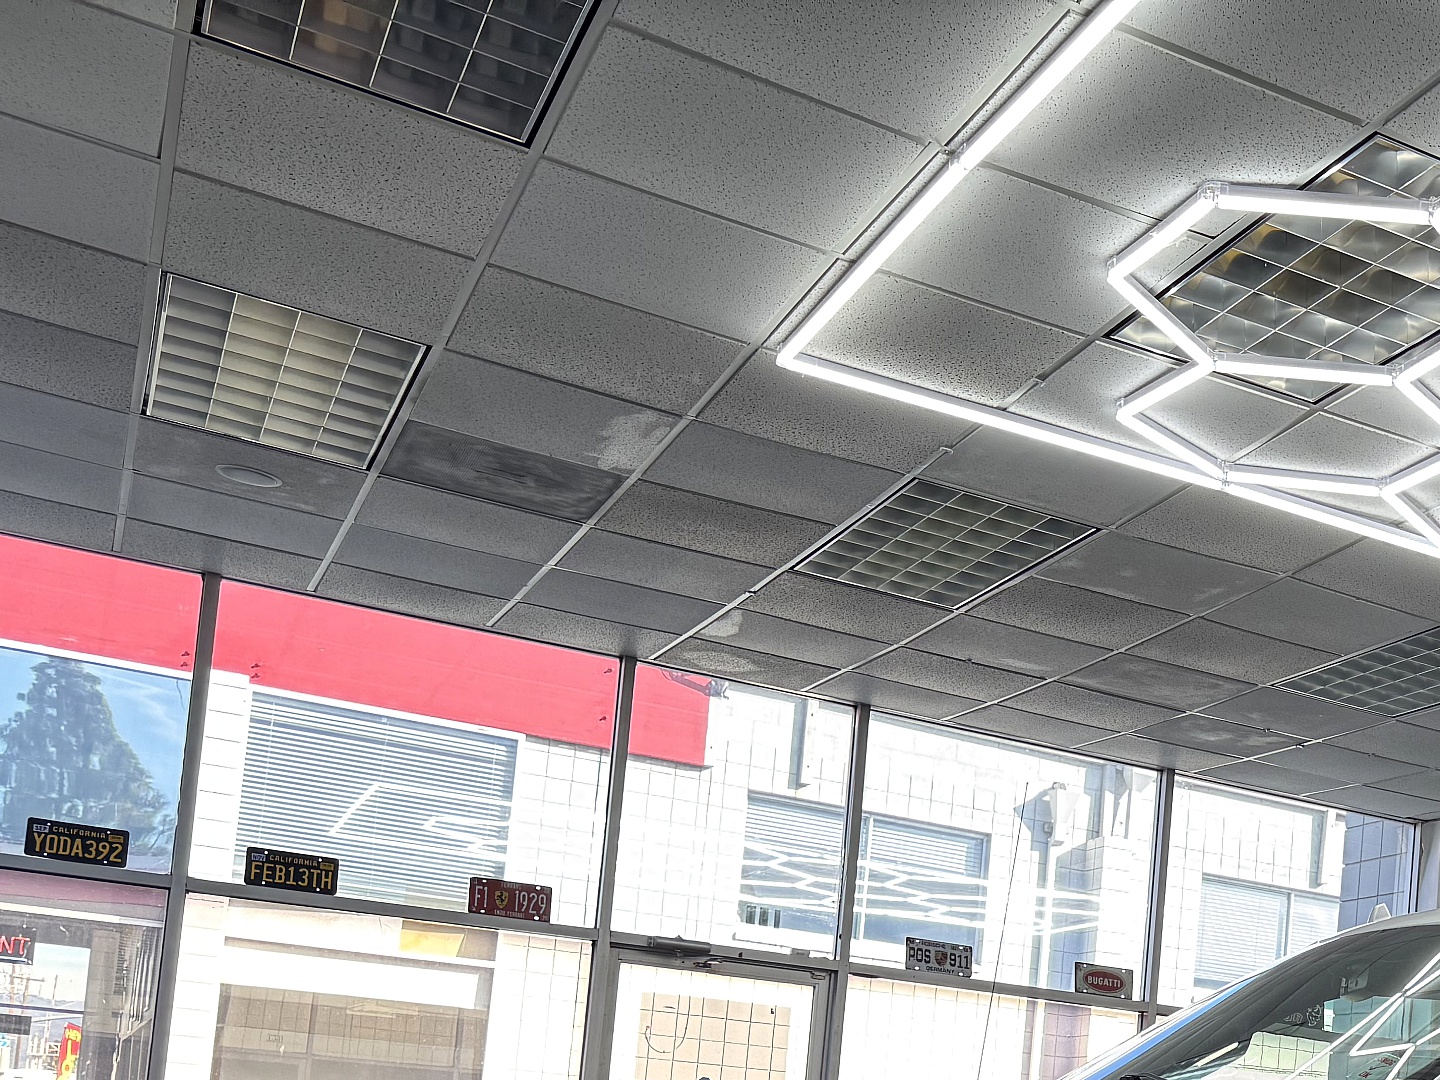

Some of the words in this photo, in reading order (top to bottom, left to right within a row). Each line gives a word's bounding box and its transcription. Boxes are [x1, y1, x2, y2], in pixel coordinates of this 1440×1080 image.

[52, 826, 106, 839] CALIFORNIA
[33, 832, 123, 863] YODA392
[269, 854, 318, 867] CALIFORNIA
[250, 861, 333, 890] FEB13TH
[474, 885, 488, 908] F1
[514, 890, 547, 914] 1929
[908, 946, 931, 964] POS
[949, 952, 970, 969] 911
[1087, 975, 1121, 988] BUGATTI
